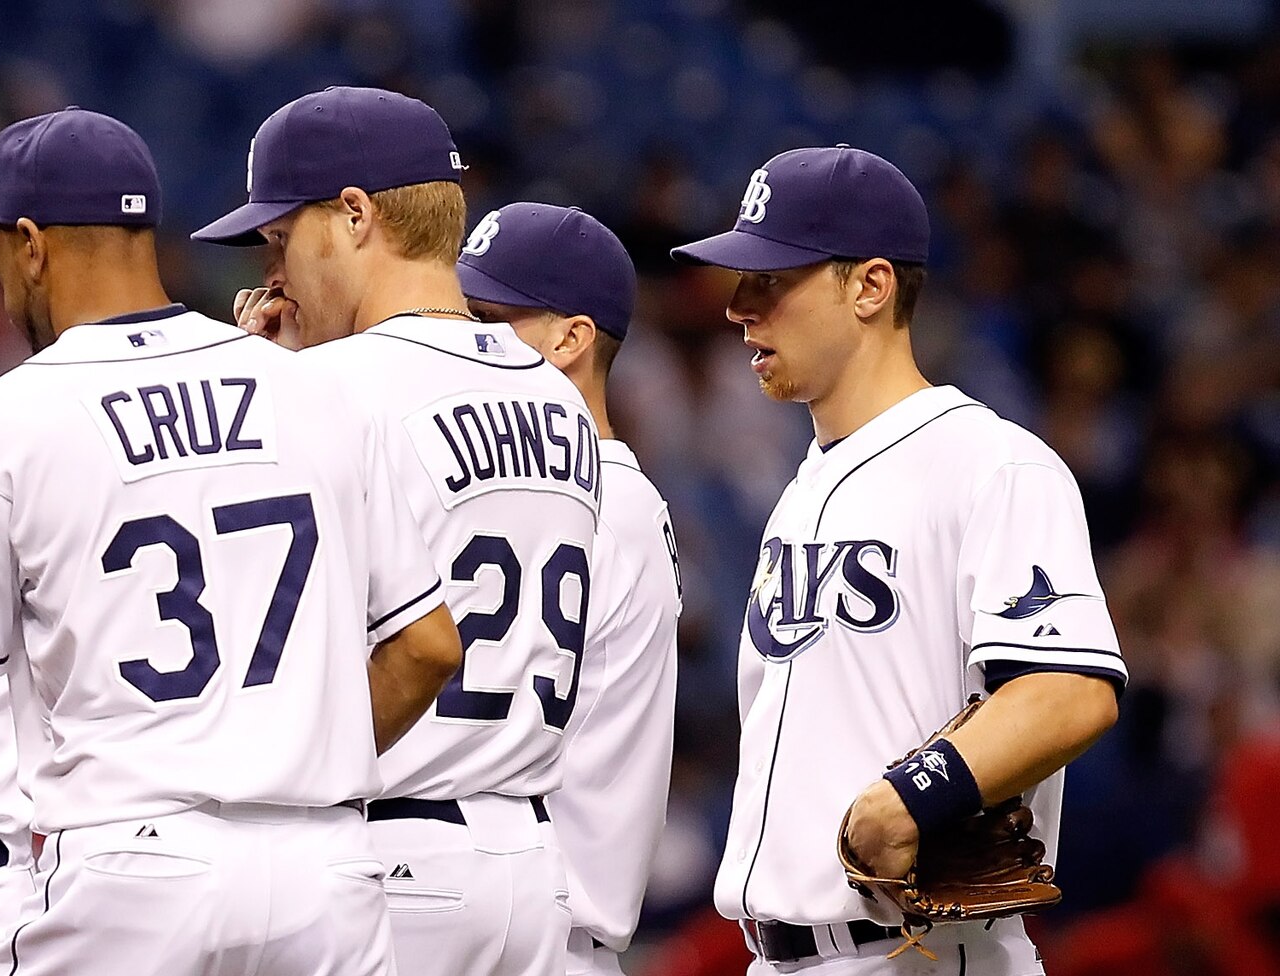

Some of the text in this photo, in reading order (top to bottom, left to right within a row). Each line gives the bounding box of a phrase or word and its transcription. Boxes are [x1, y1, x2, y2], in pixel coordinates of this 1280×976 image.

[101, 378, 263, 466] CRUZ
[433, 401, 601, 504] JOHNSO
[101, 492, 319, 703] 37
[435, 534, 591, 731] 29
[747, 536, 901, 664] RAYS
[904, 761, 932, 791] 18
